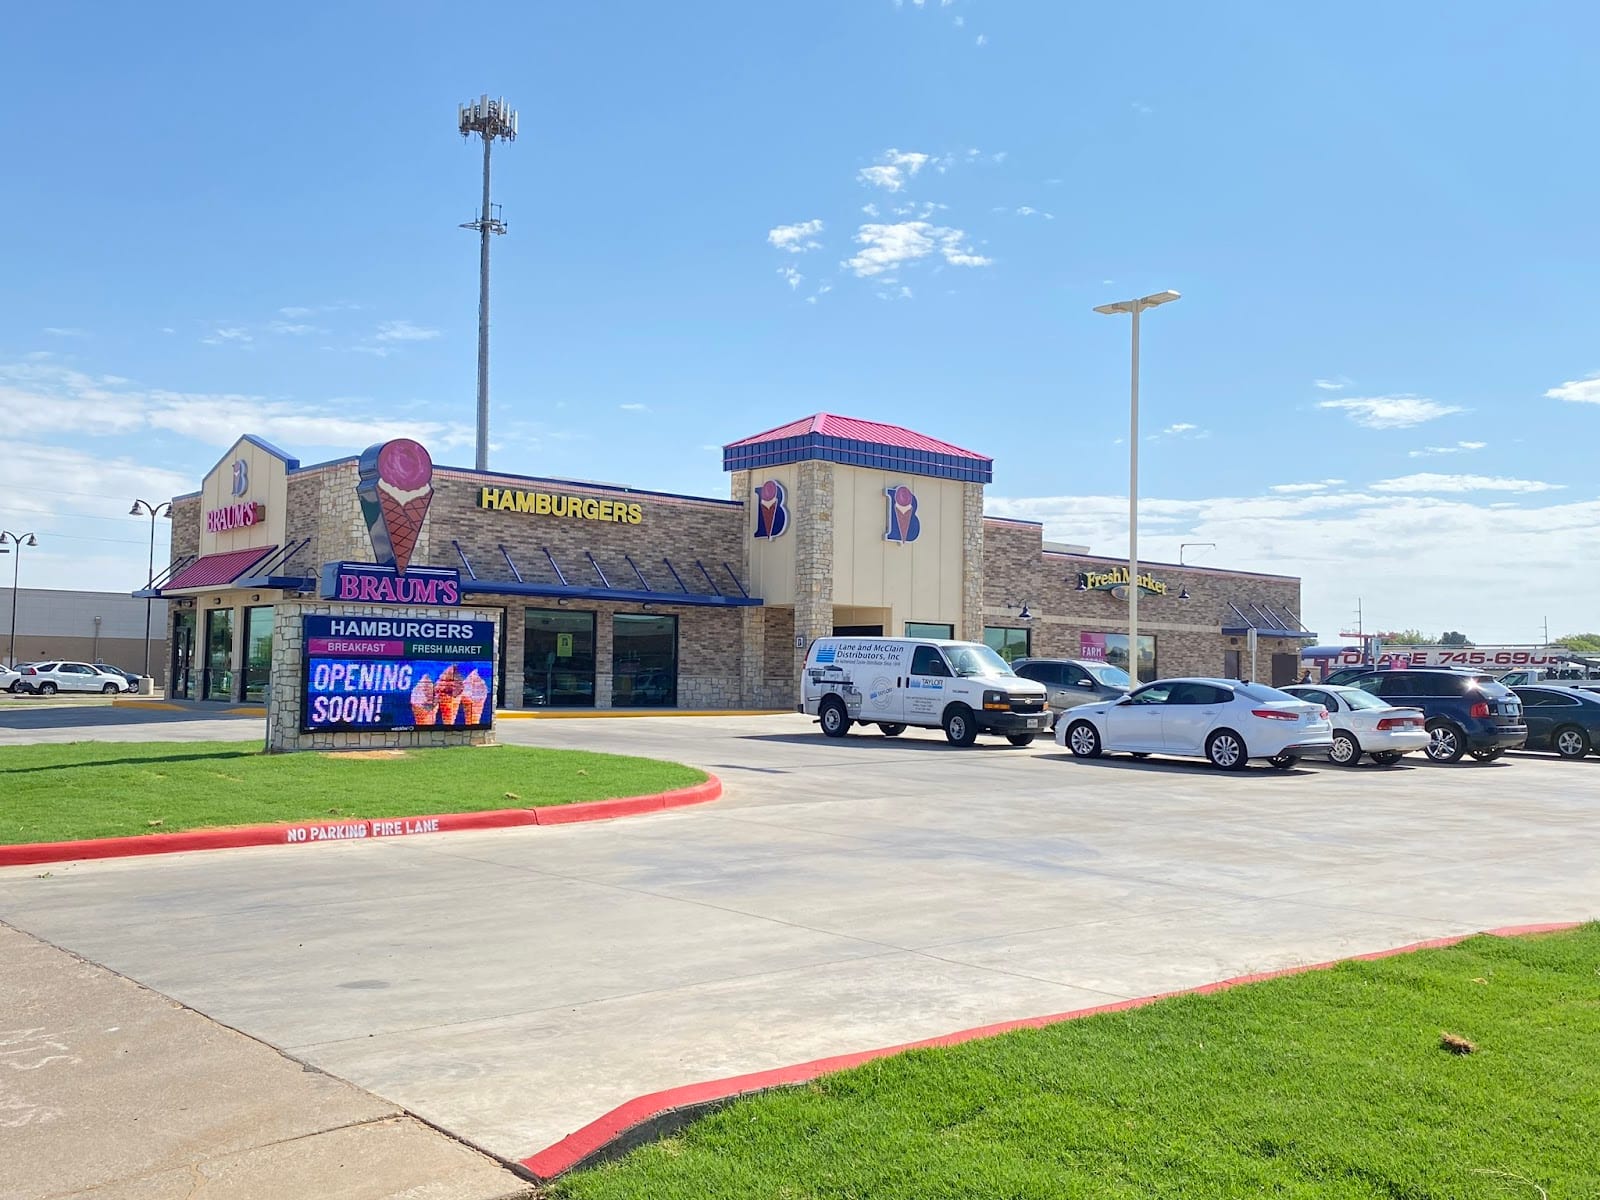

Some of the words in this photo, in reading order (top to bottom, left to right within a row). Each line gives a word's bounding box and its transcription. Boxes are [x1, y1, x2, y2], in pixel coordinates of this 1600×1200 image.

[206, 501, 258, 533] BRAUM'S
[480, 487, 643, 525] HAMBURGERS
[339, 574, 459, 604] BRAUM'S
[1086, 567, 1122, 590] Fresh
[330, 620, 474, 639] HAMBURGERS
[327, 642, 386, 653] BREAKFAST
[412, 644, 443, 654] FRESH
[444, 645, 482, 655] MARKET
[837, 650, 886, 660] Distributors,
[838, 643, 856, 651] Lane
[874, 644, 904, 653] McClain
[1082, 646, 1102, 657] FARM
[314, 664, 413, 691] OPENING
[312, 695, 384, 723] SOON!
[287, 828, 307, 842] NO
[310, 823, 368, 840] PARKING
[372, 821, 403, 836] FIRE
[406, 819, 440, 833] LANE
